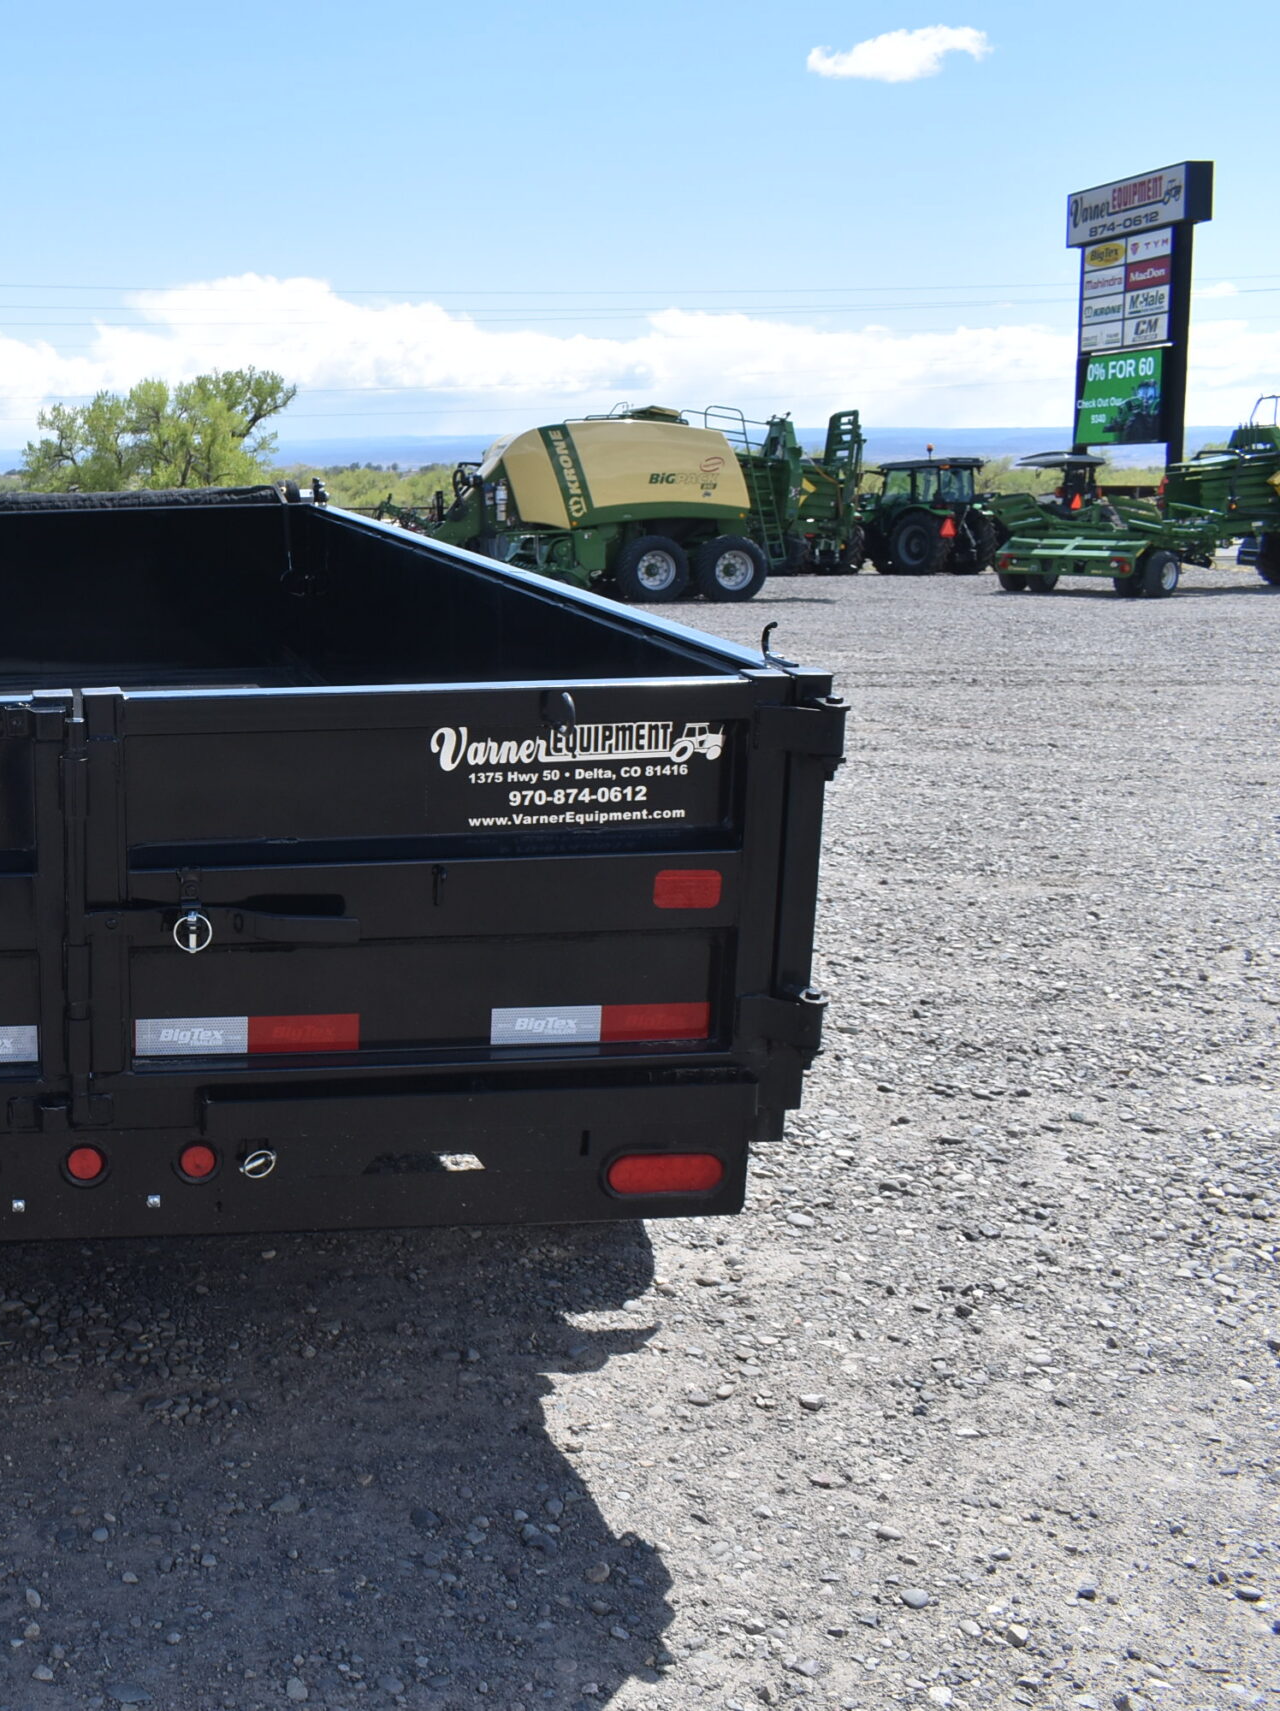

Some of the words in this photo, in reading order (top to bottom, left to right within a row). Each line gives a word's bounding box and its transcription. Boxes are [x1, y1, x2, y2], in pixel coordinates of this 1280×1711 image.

[1070, 195, 1110, 229] Varner
[1111, 175, 1164, 211] EQUIPMENT
[1088, 210, 1160, 238] 874-0612
[1144, 237, 1169, 250] TYM
[1090, 247, 1119, 262] BigTex
[1129, 267, 1166, 283] MacDon
[1093, 303, 1123, 317] KRONE
[1134, 317, 1159, 336] CM
[1087, 363, 1106, 382] 0%
[1108, 359, 1136, 380] FOR
[1138, 356, 1154, 377] 60
[1077, 399, 1096, 409] Check
[1097, 398, 1109, 408] Out
[548, 429, 582, 495] KRONE
[429, 726, 548, 772] Varner
[550, 721, 674, 758] EQUIPMENT
[468, 771, 504, 785] 1375
[507, 770, 538, 784] Hwy
[542, 769, 561, 782] 50
[574, 767, 617, 781] Delta,
[620, 766, 641, 779] CO
[645, 764, 689, 777] 81416
[508, 785, 648, 807] 970-874-0612
[468, 808, 687, 828] www.VarnerEquipment.com
[515, 1017, 578, 1032] BigTex
[159, 1028, 224, 1044] BigTex
